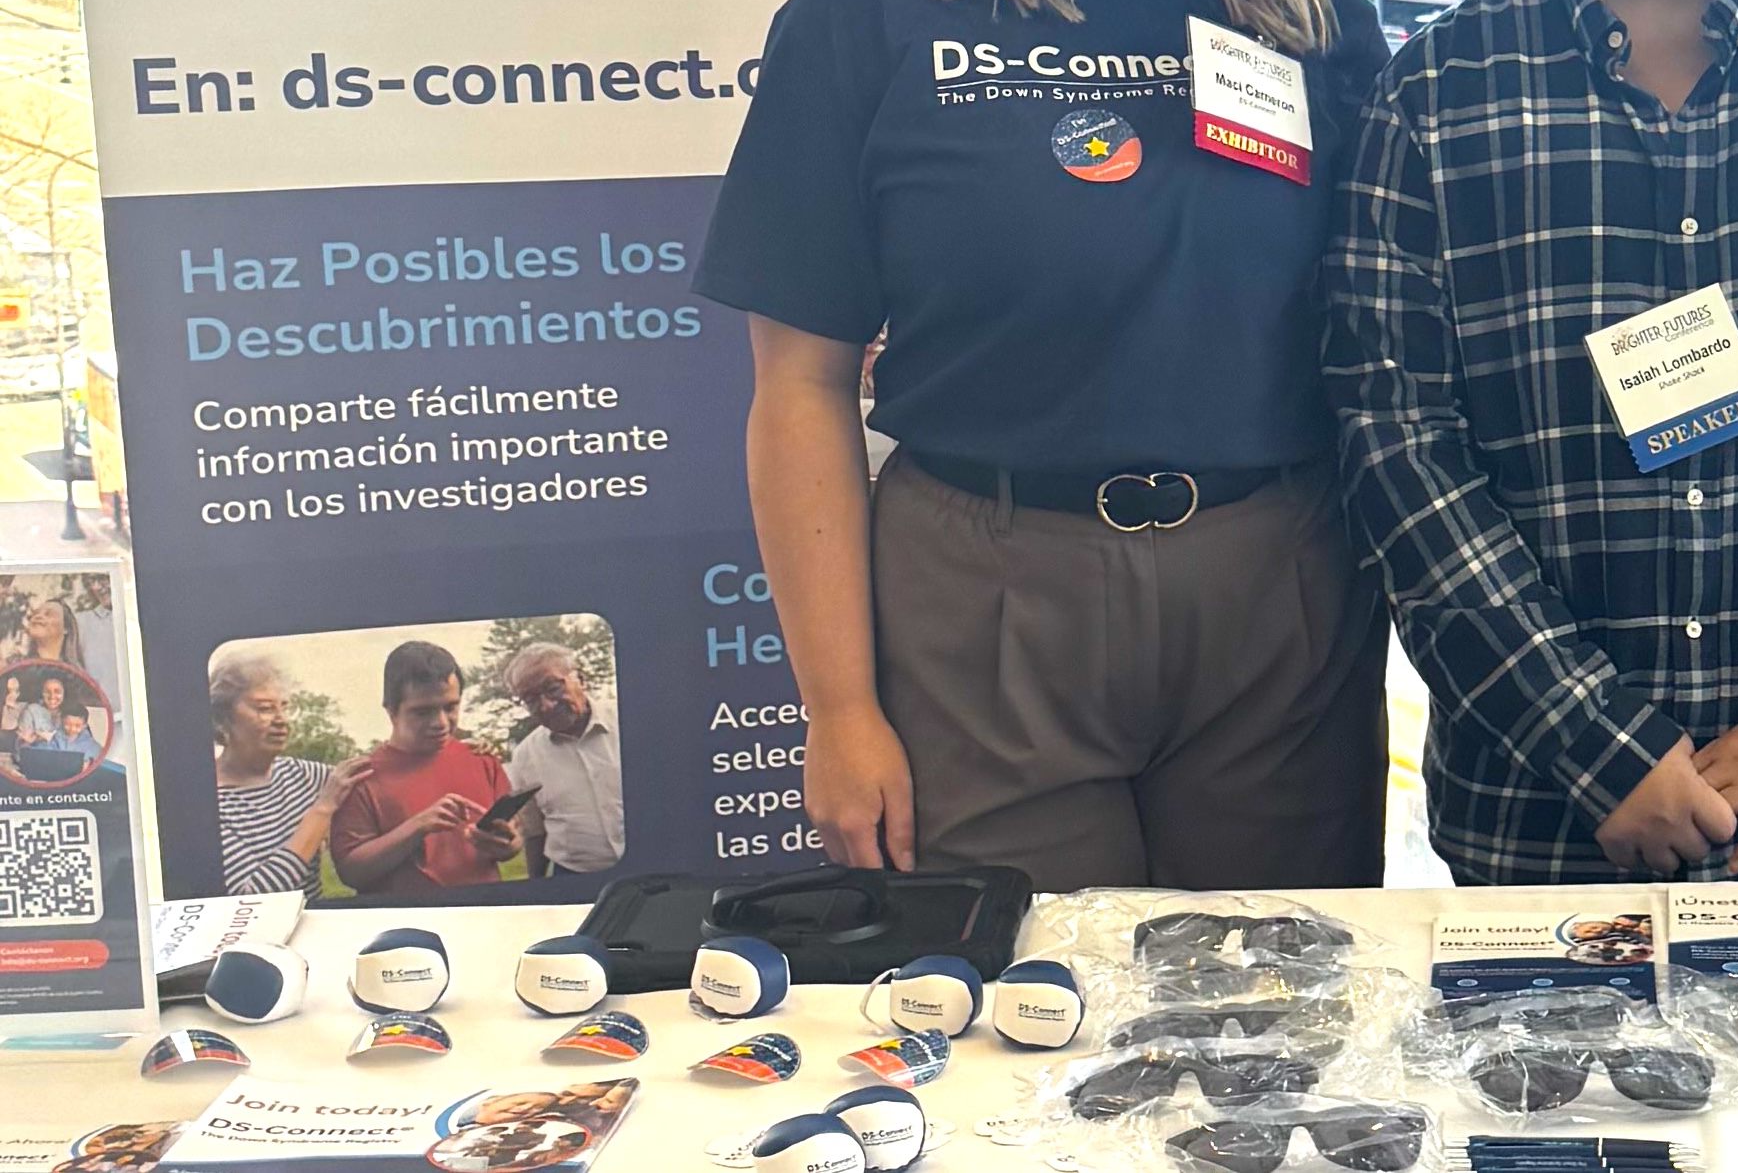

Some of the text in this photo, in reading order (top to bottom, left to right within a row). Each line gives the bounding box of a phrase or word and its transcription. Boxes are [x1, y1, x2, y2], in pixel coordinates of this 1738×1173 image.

[932, 39, 1191, 81] DS-Conne
[132, 57, 257, 116] En:
[936, 92, 976, 106] The
[985, 86, 1044, 100] Down
[1053, 87, 1154, 104] Syndrome
[1245, 83, 1296, 115] Cameron
[1206, 122, 1299, 170] EXHIBITOR
[179, 232, 687, 296] Haz Posibles los
[186, 301, 703, 363] Descubrimientos
[1663, 304, 1713, 337] FUTURES
[1619, 337, 1733, 392] Isaiah Lombardo
[193, 380, 621, 435] Comparte fácilmente
[196, 423, 670, 480] información importante
[201, 469, 650, 526] con los investigadores
[710, 701, 812, 731] Acce
[26, 794, 43, 805] en
[47, 790, 113, 805] contacto!
[714, 788, 803, 819] expe
[716, 830, 770, 860] las
[228, 899, 263, 928] Join
[1440, 925, 1550, 936] Join today!
[226, 1094, 433, 1118] Join today!
